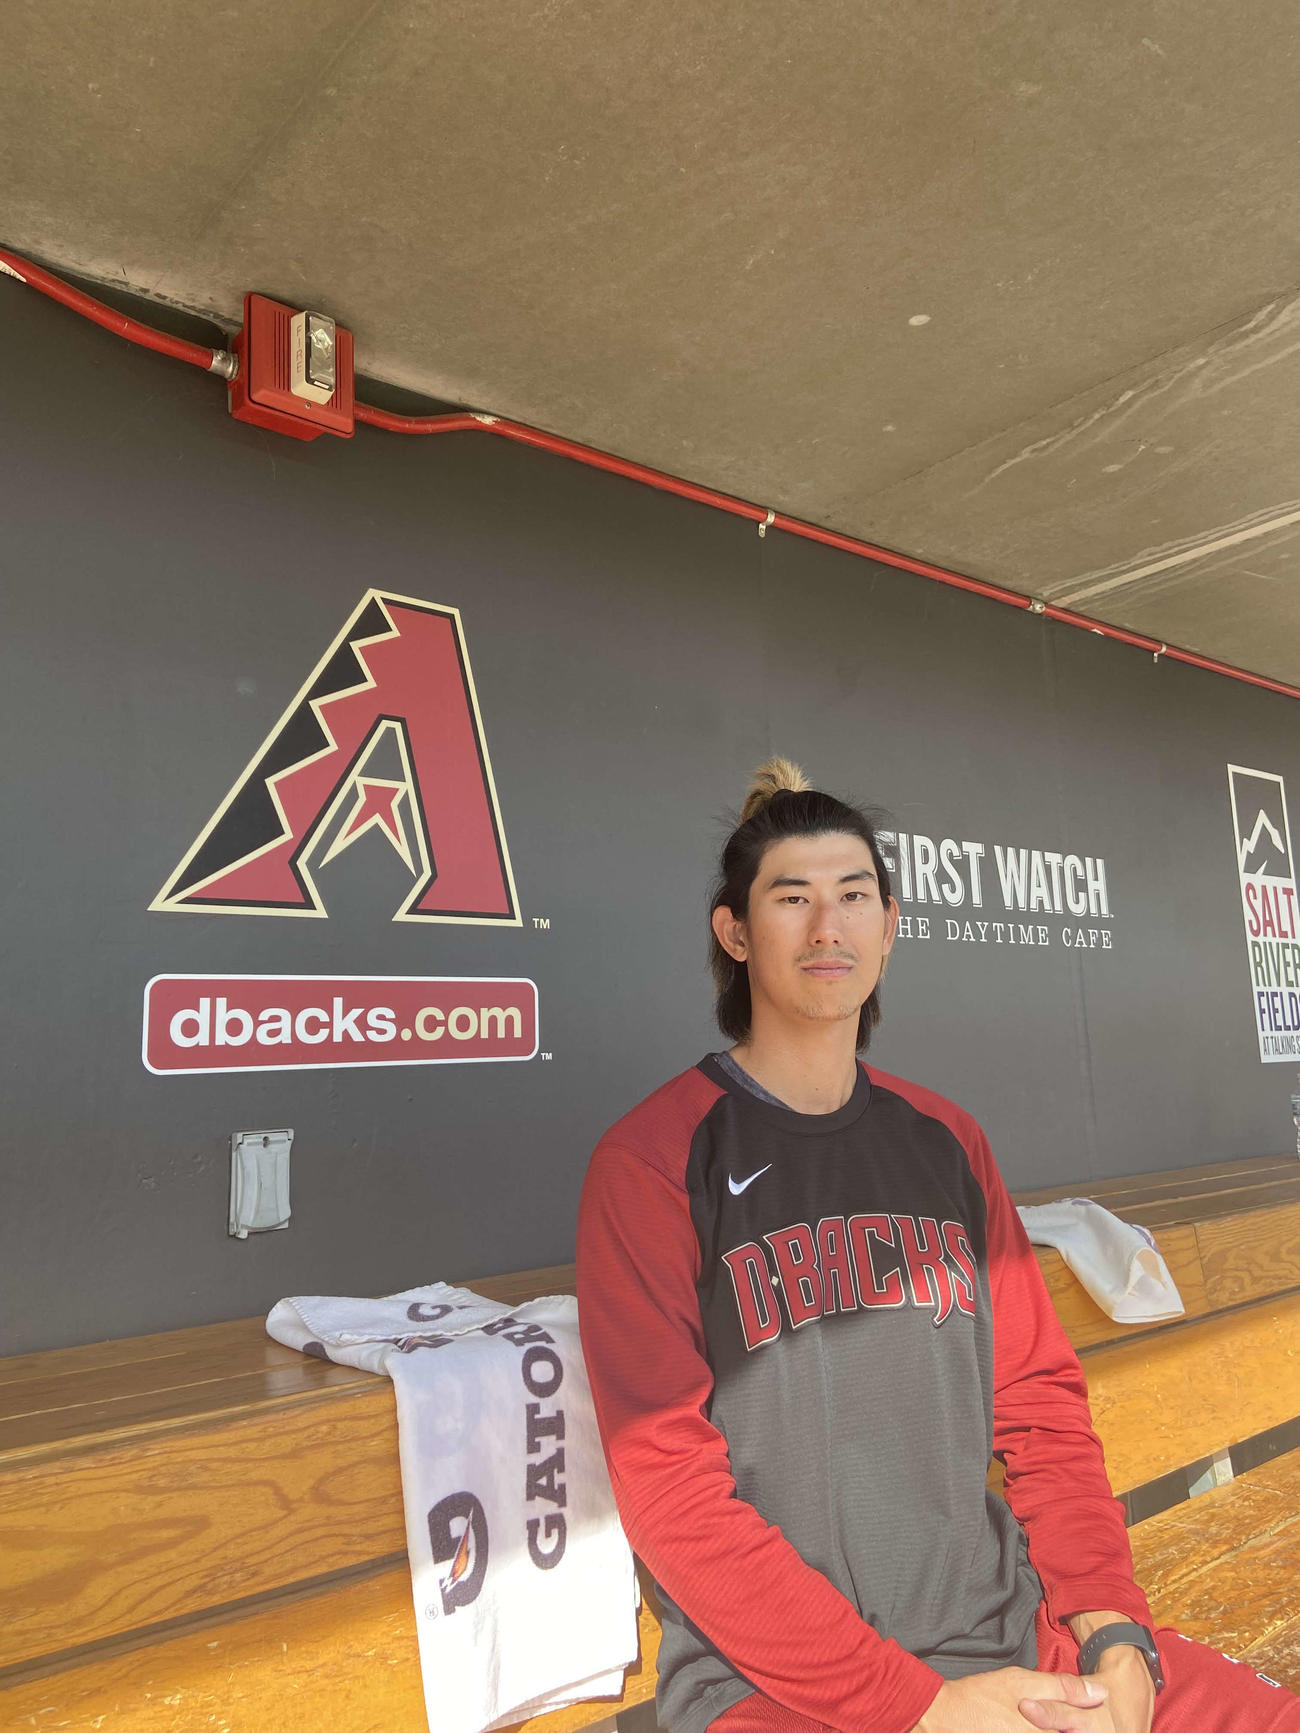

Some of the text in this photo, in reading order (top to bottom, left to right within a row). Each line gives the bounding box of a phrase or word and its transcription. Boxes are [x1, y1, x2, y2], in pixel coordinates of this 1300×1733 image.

[994, 844, 1110, 918] WATCH
[532, 917, 551, 930] TM
[1245, 881, 1296, 940] SALT
[897, 916, 1112, 949] HE DAYTIME CAFE
[169, 997, 522, 1046] dbacks.com
[1257, 991, 1300, 1032] FIELD
[1263, 1036, 1270, 1056] AT
[1270, 1035, 1296, 1055] TALKING
